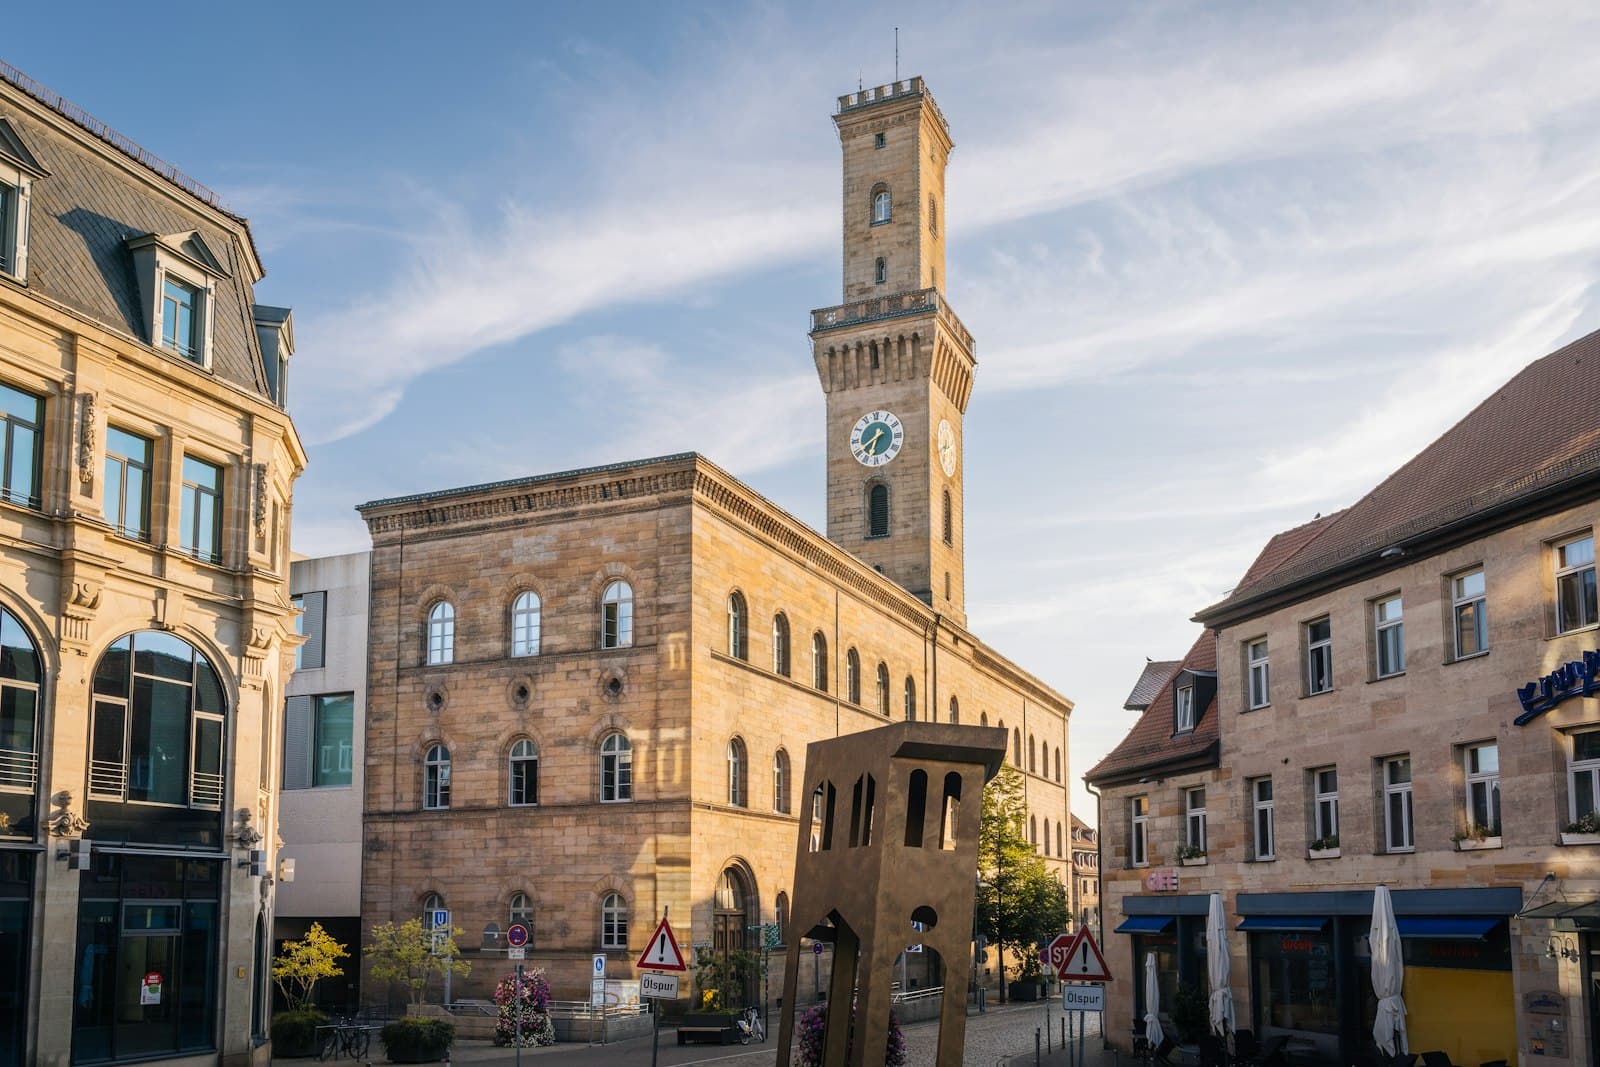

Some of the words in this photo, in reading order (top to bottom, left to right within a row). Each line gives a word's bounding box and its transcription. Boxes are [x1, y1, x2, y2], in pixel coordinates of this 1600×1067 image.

[437, 912, 445, 925] U
[1053, 946, 1069, 963] ST
[643, 976, 675, 992] Ölspur
[1067, 991, 1100, 1005] Ölspur
